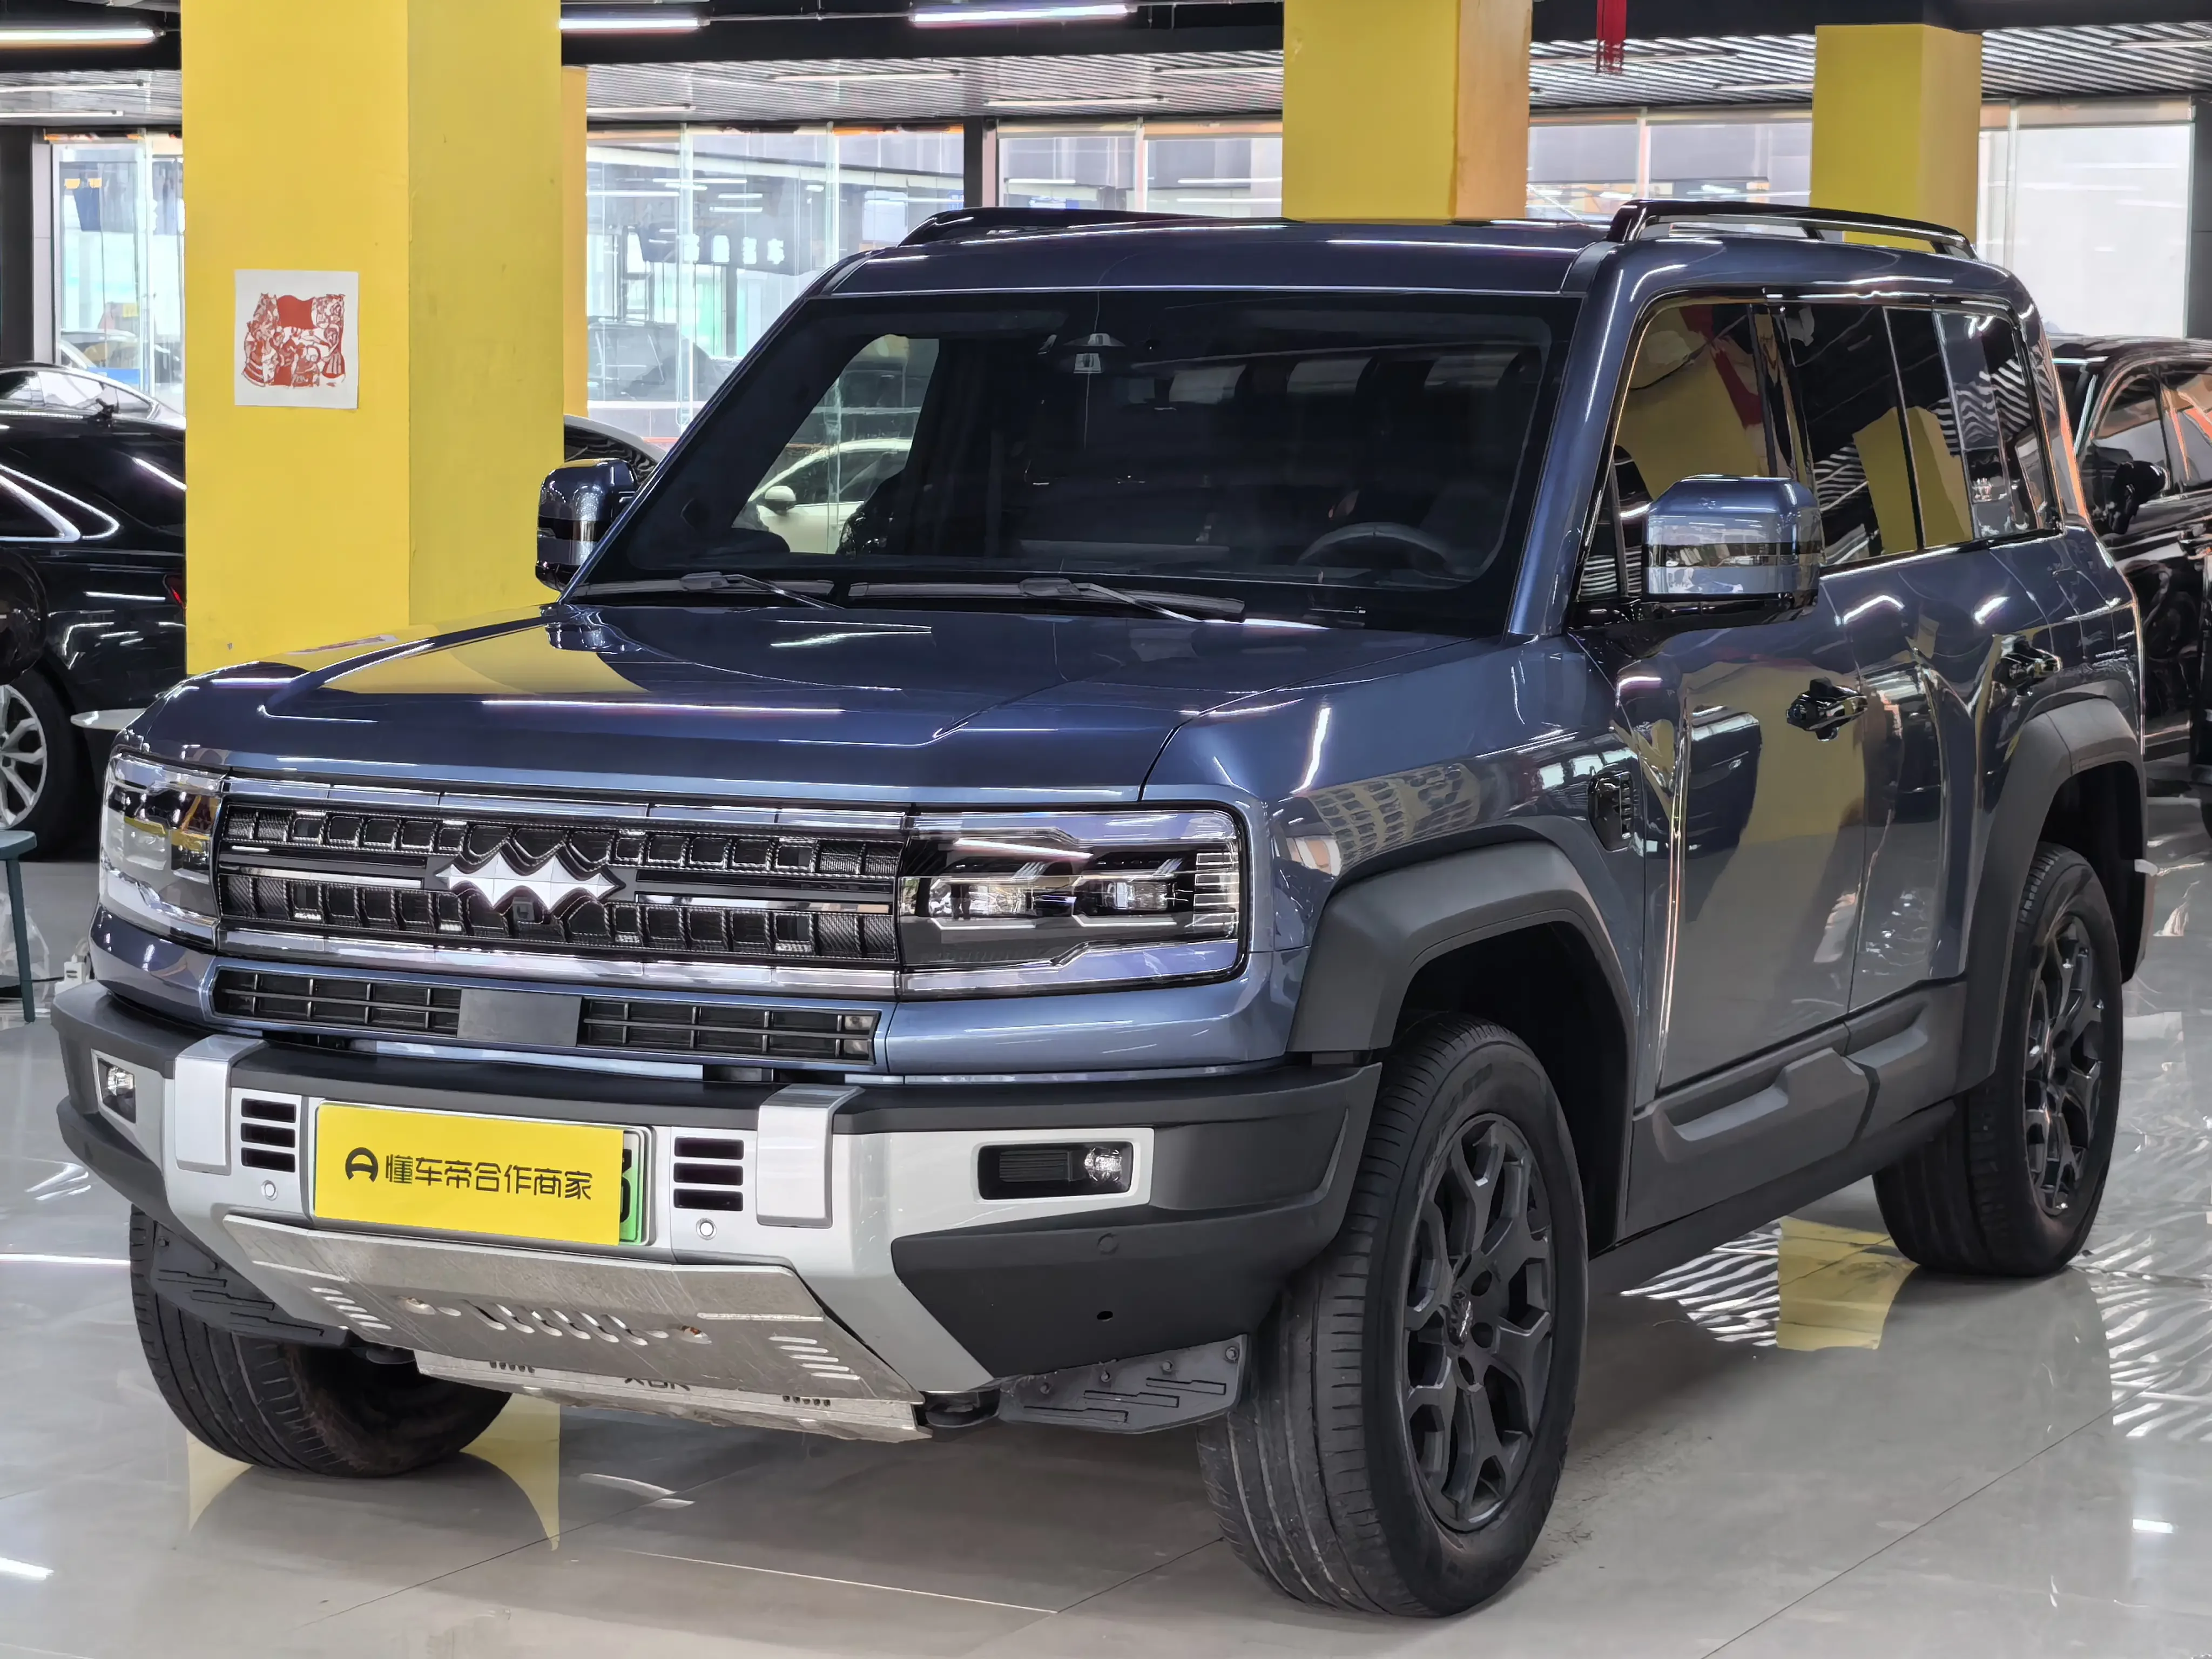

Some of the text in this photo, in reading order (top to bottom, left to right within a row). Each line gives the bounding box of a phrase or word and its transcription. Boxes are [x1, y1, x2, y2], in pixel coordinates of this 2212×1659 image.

[386, 1154, 593, 1200] 懂车帝合作商家
